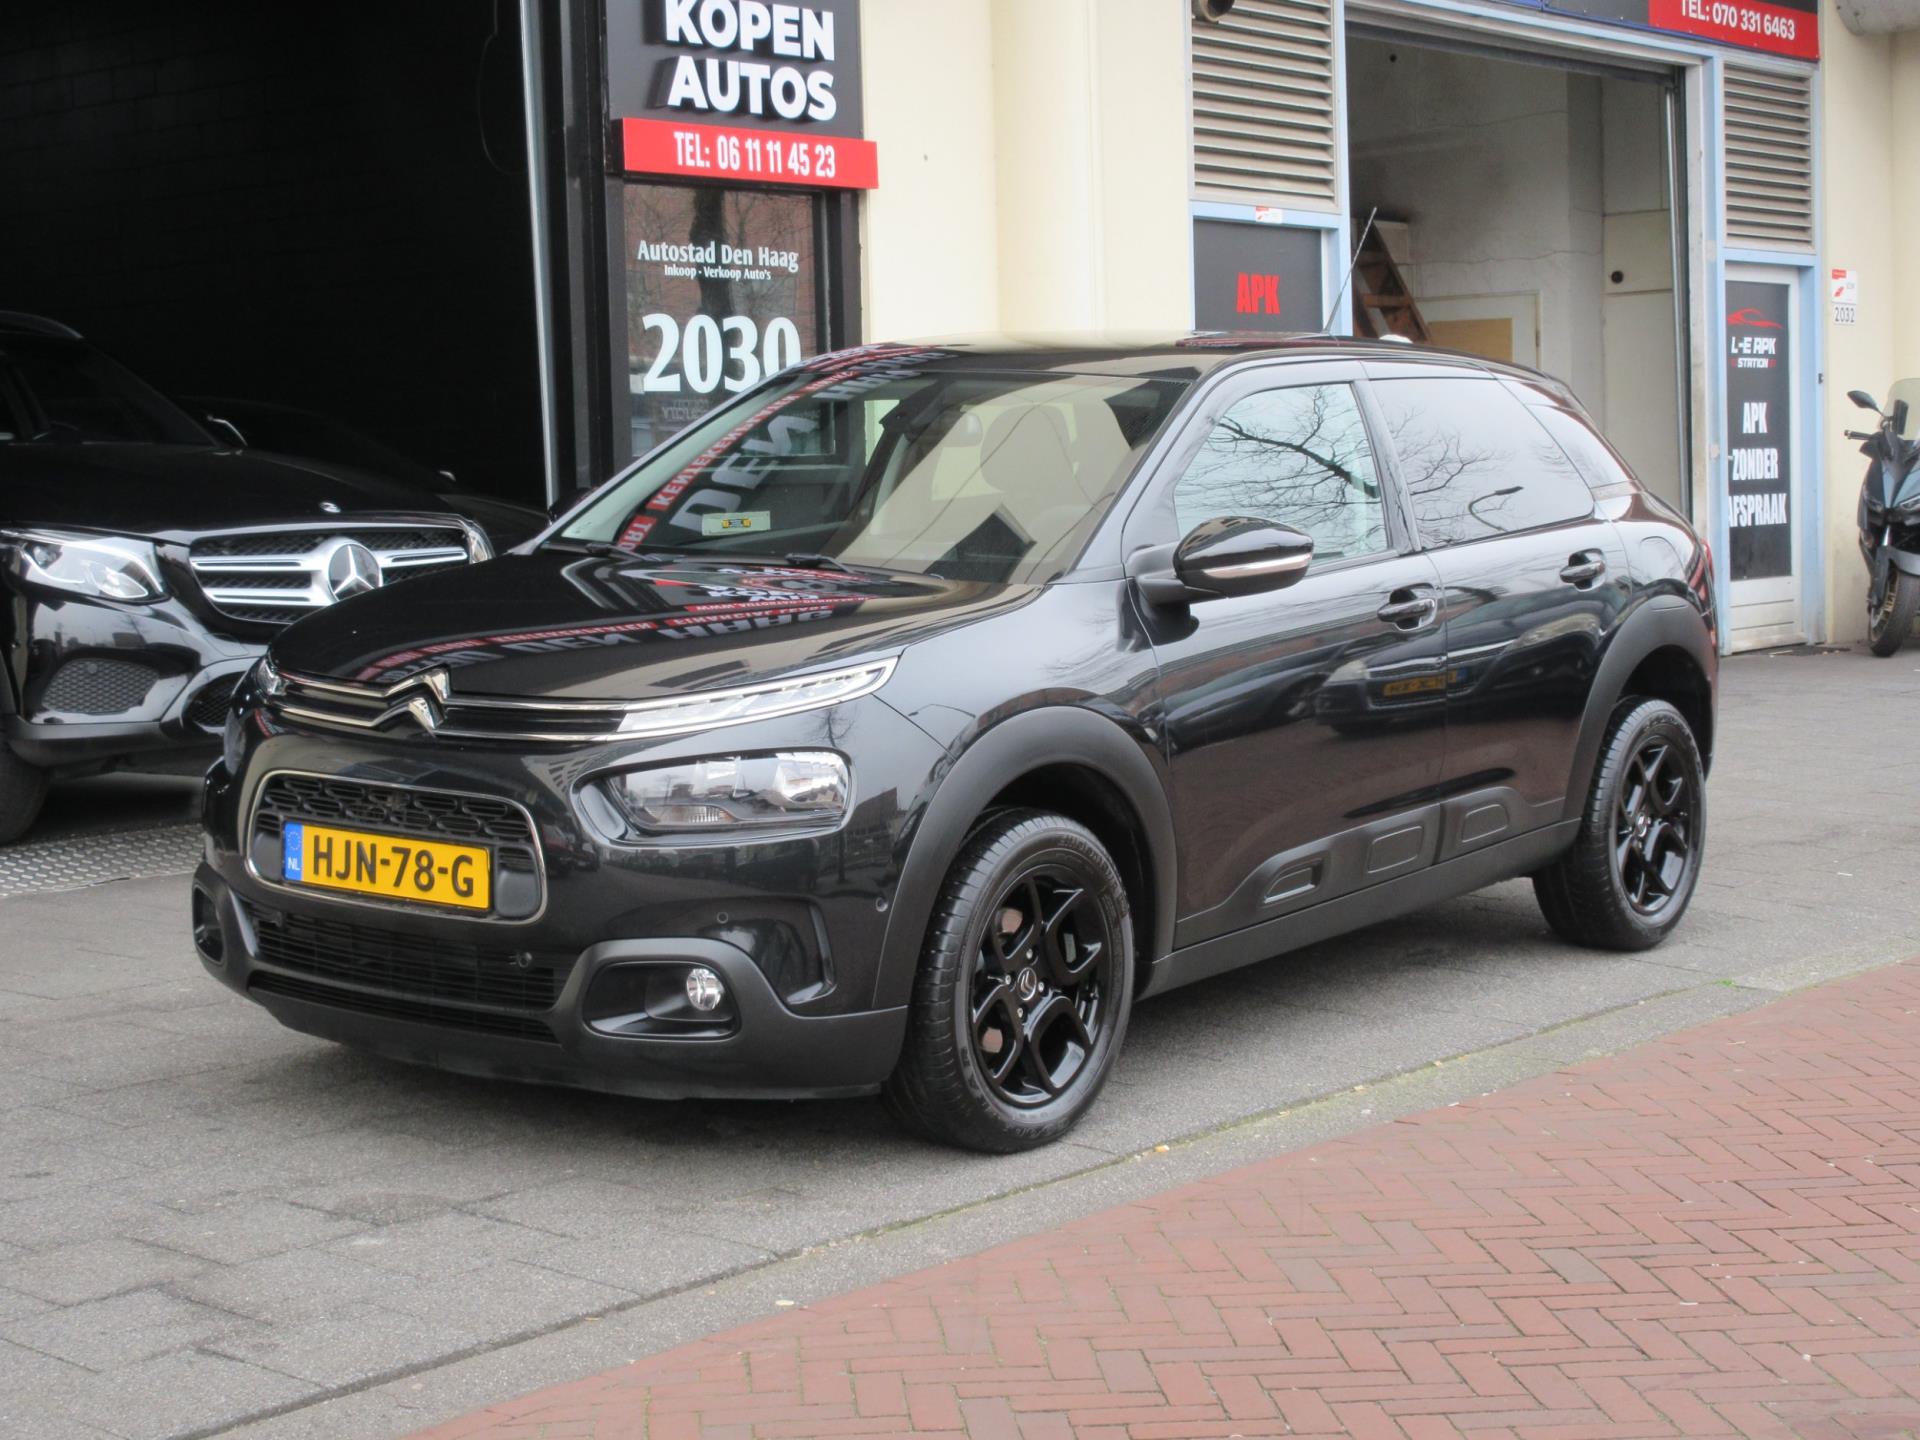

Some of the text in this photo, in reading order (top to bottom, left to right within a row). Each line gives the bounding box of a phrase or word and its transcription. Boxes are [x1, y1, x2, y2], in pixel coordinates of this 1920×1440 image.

[664, 0, 835, 61] KOPEN
[1713, 2, 1738, 28] 070
[1740, 9, 1761, 33] 331
[1764, 14, 1796, 41] 6463
[667, 55, 837, 122] AUTOS
[674, 131, 836, 178] TEL: 06 11 11 45 23
[637, 240, 799, 273] Autostad Den Haag
[664, 264, 771, 282] Inkoop Verkoop Auto's
[1236, 271, 1280, 314] APK
[1834, 307, 1856, 323] 2032
[642, 313, 801, 394] 2030
[1731, 336, 1776, 355] L-E APK
[1737, 357, 1769, 369] STATION
[1742, 402, 1767, 434] APK
[1732, 448, 1779, 481] ZONDER
[287, 857, 301, 872] NL
[312, 835, 475, 898] HJN-78-G
